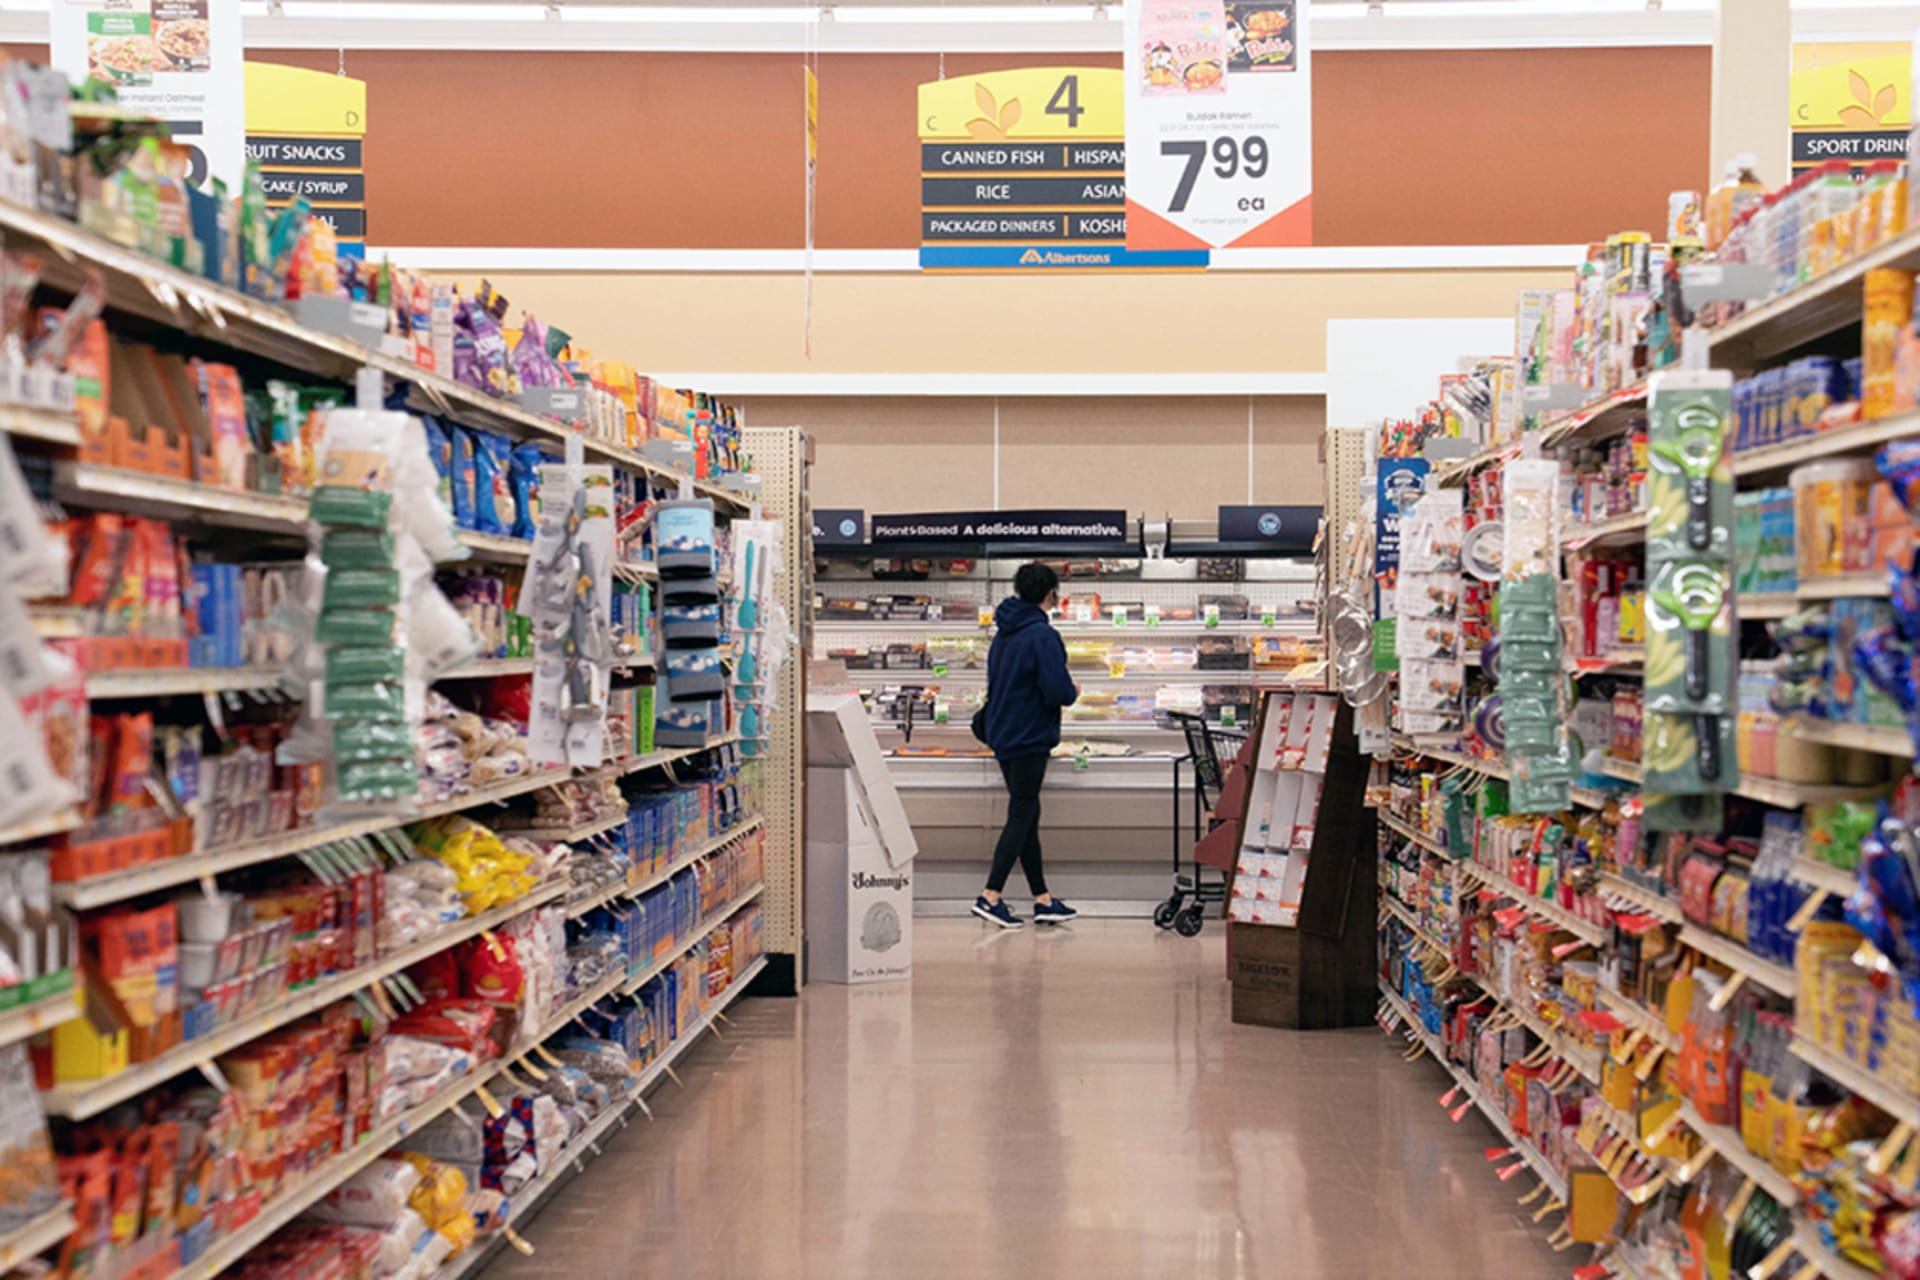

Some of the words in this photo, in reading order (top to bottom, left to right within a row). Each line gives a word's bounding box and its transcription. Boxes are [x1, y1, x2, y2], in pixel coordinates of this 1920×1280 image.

[1044, 75, 1085, 129] 4
[345, 110, 360, 127] D
[1797, 103, 1809, 120] C
[926, 115, 938, 131] C
[245, 144, 279, 159] RUIT
[282, 145, 346, 161] SNACKS
[1806, 138, 1861, 154] SPORT
[941, 150, 1008, 165] CANNED
[1010, 150, 1045, 165] FISH
[1159, 140, 1207, 213] 7
[1212, 135, 1269, 179] 99
[260, 180, 297, 192] CAKE
[305, 181, 349, 194] SYRUP
[975, 184, 1011, 199] RICE
[1237, 196, 1265, 211] ea
[930, 220, 997, 233] PACKAGED
[1000, 220, 1056, 233] DINNERS
[1043, 251, 1111, 264] Albertsons
[963, 525, 974, 535] A
[976, 522, 1038, 535] delicious
[1041, 521, 1123, 536] alternative.
[851, 871, 910, 891] Johnny's
